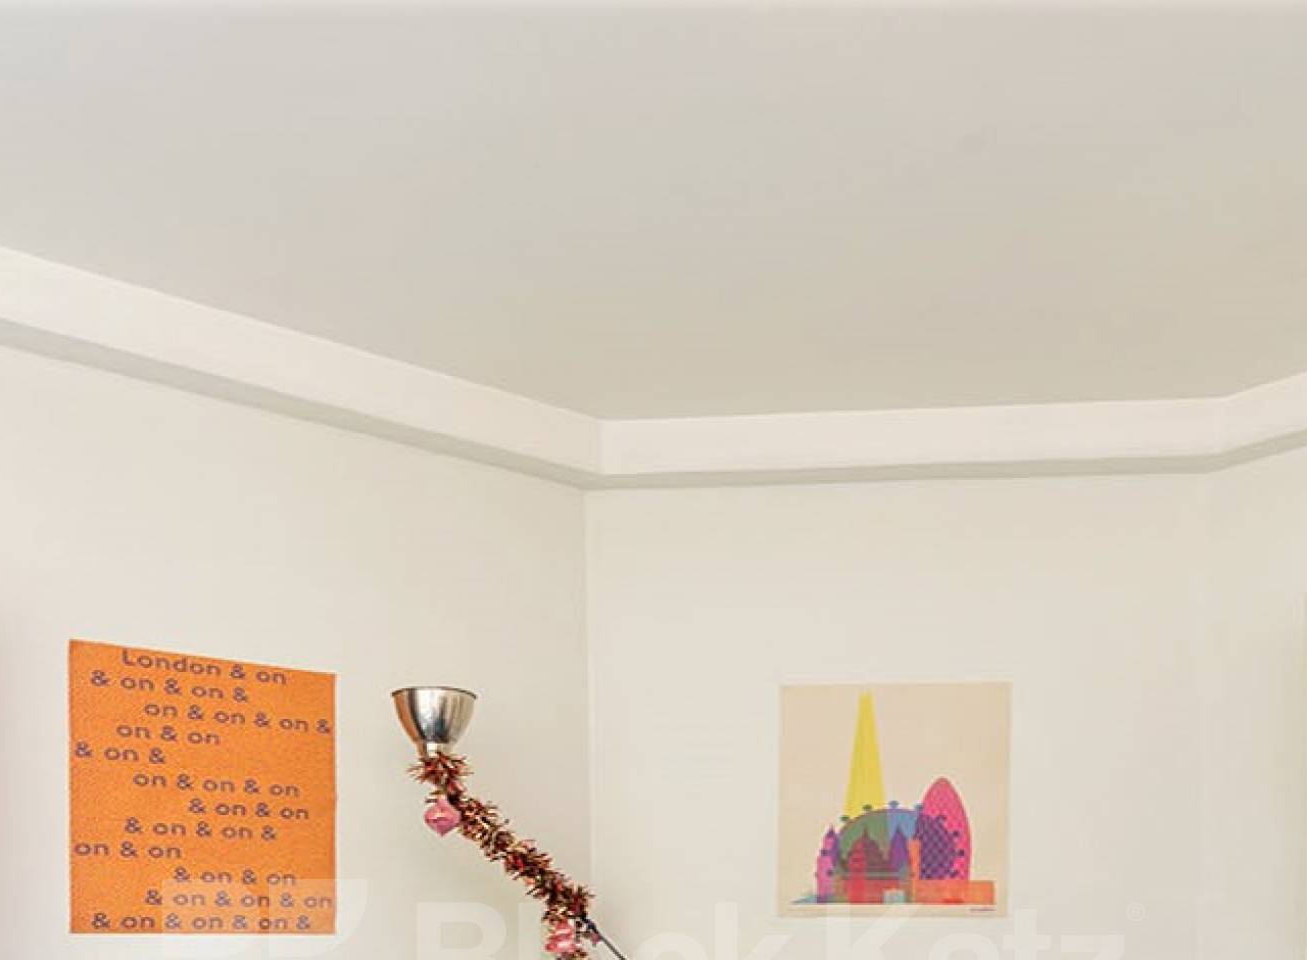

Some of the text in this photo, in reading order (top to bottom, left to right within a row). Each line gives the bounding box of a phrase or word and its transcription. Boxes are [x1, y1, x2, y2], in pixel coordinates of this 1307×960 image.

[121, 647, 287, 684] London & on
[91, 670, 248, 702] & on & on &
[144, 704, 330, 734] on & on & on &
[116, 724, 221, 745] on & on
[75, 741, 165, 764] & on &
[133, 773, 300, 796] on & on & on
[188, 798, 309, 820] & on & on
[124, 817, 276, 840] & on & on &
[74, 842, 181, 858] on & on
[174, 866, 296, 886] & on & on
[146, 889, 162, 905] &
[173, 893, 205, 906] on
[241, 893, 270, 907] on
[304, 895, 333, 908] on
[92, 913, 110, 929] &
[121, 914, 155, 929] on
[165, 913, 181, 929] &
[193, 915, 223, 929] on
[259, 916, 288, 930] on
